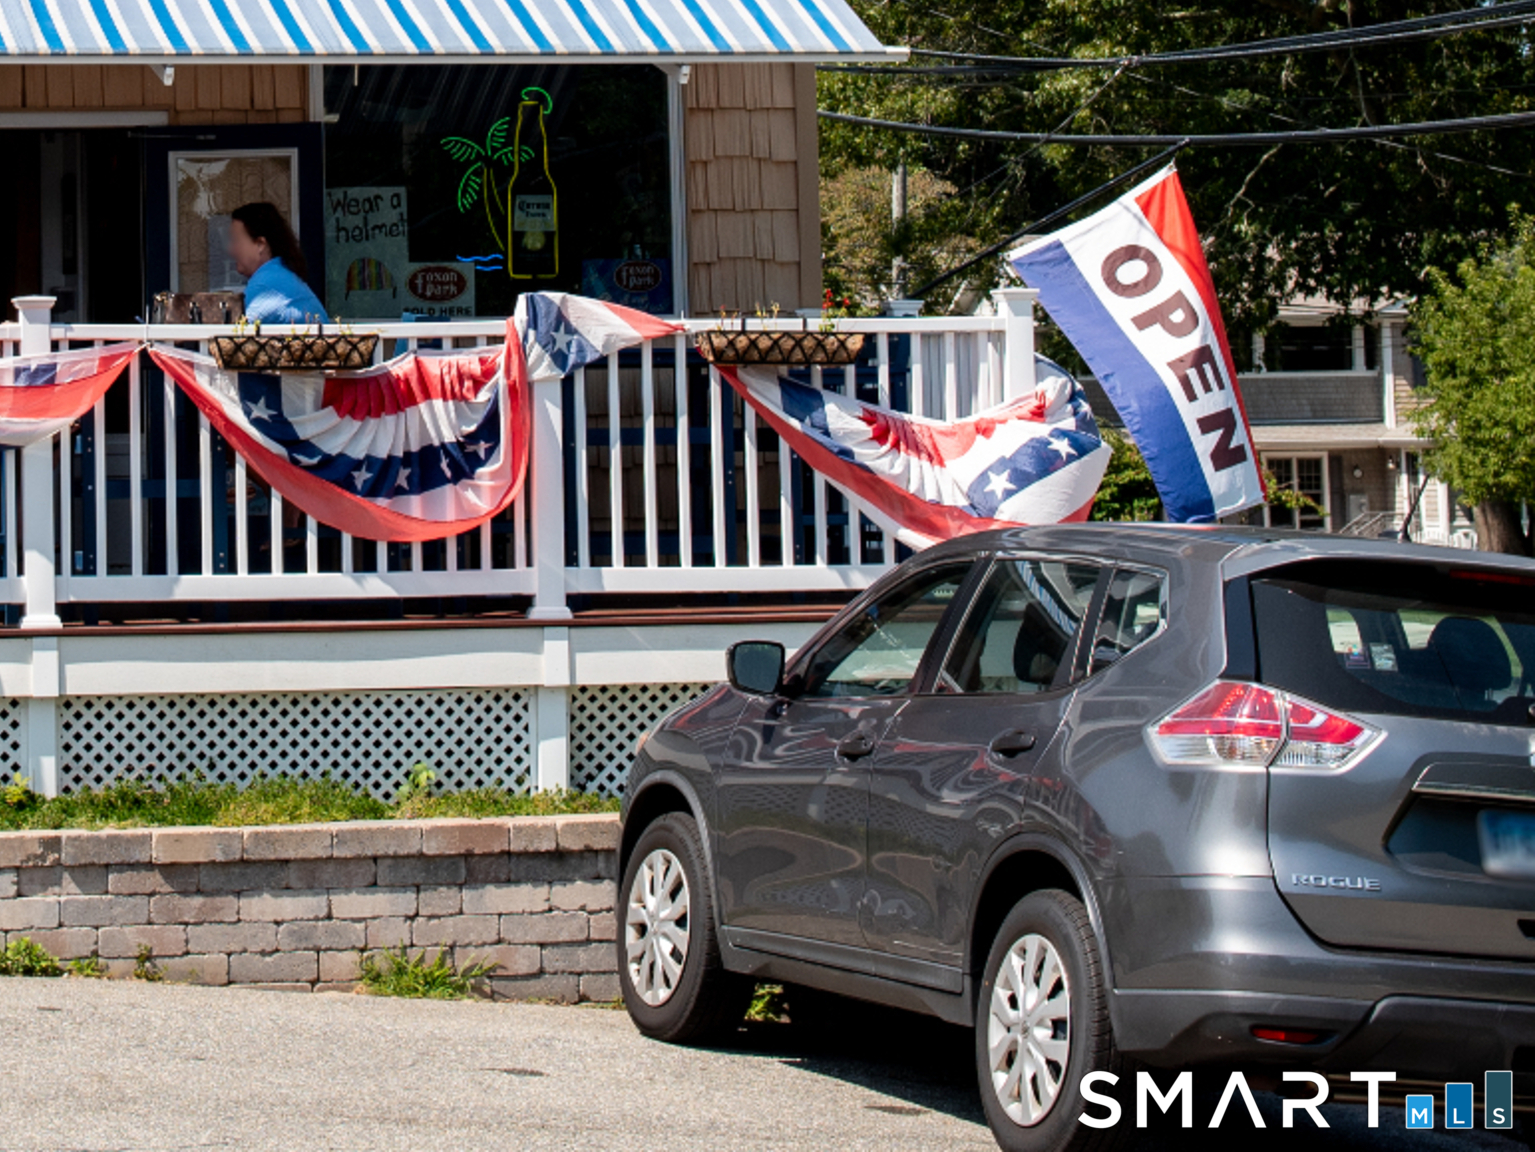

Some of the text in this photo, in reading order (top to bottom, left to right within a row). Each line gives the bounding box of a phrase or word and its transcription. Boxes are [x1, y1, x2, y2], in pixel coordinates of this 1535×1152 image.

[327, 190, 402, 217] Wear a
[335, 212, 407, 244] helmet
[440, 306, 473, 317] HERE
[1101, 244, 1248, 473] OPEN
[1291, 872, 1381, 891] ROGUE
